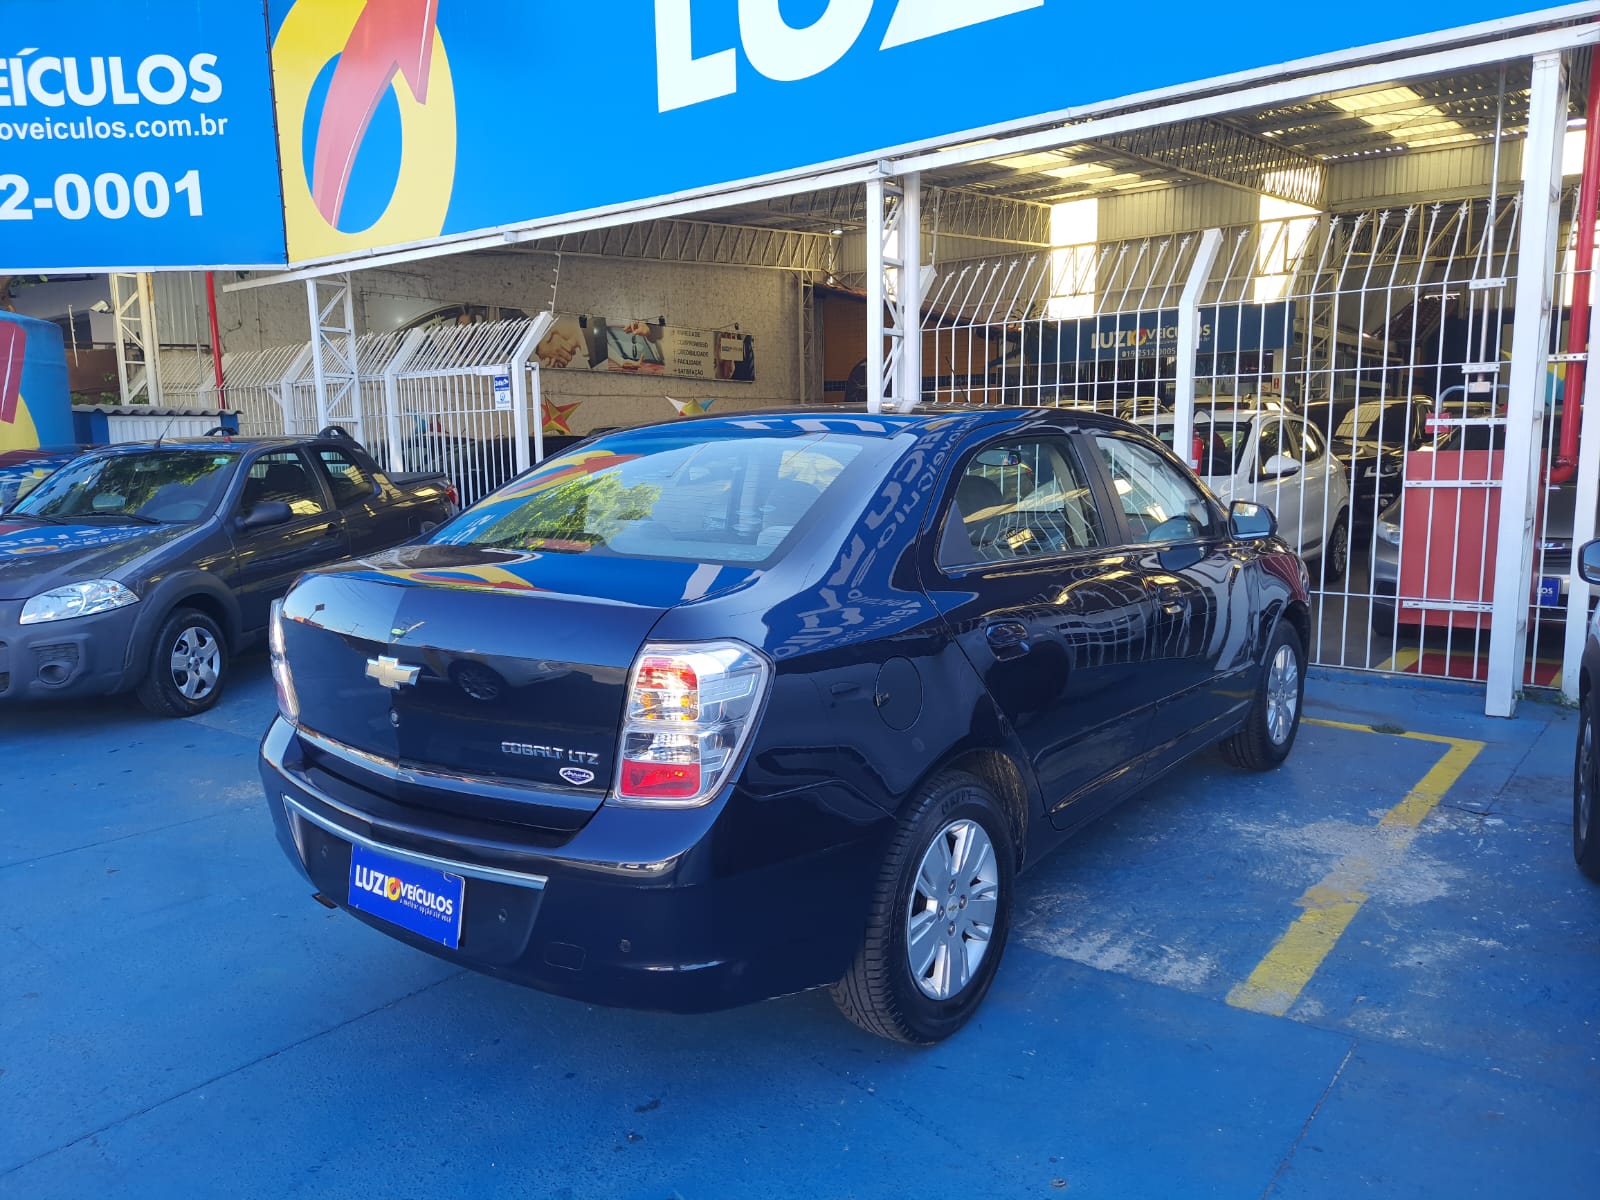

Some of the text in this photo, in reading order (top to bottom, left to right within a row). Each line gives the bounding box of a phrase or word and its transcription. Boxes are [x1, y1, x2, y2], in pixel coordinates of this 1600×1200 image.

[0, 169, 203, 221] 2-0001
[1145, 323, 1211, 340] VEÍCS
[501, 741, 600, 765] COBALT LTZ
[399, 880, 453, 915] VEÍCULOS
